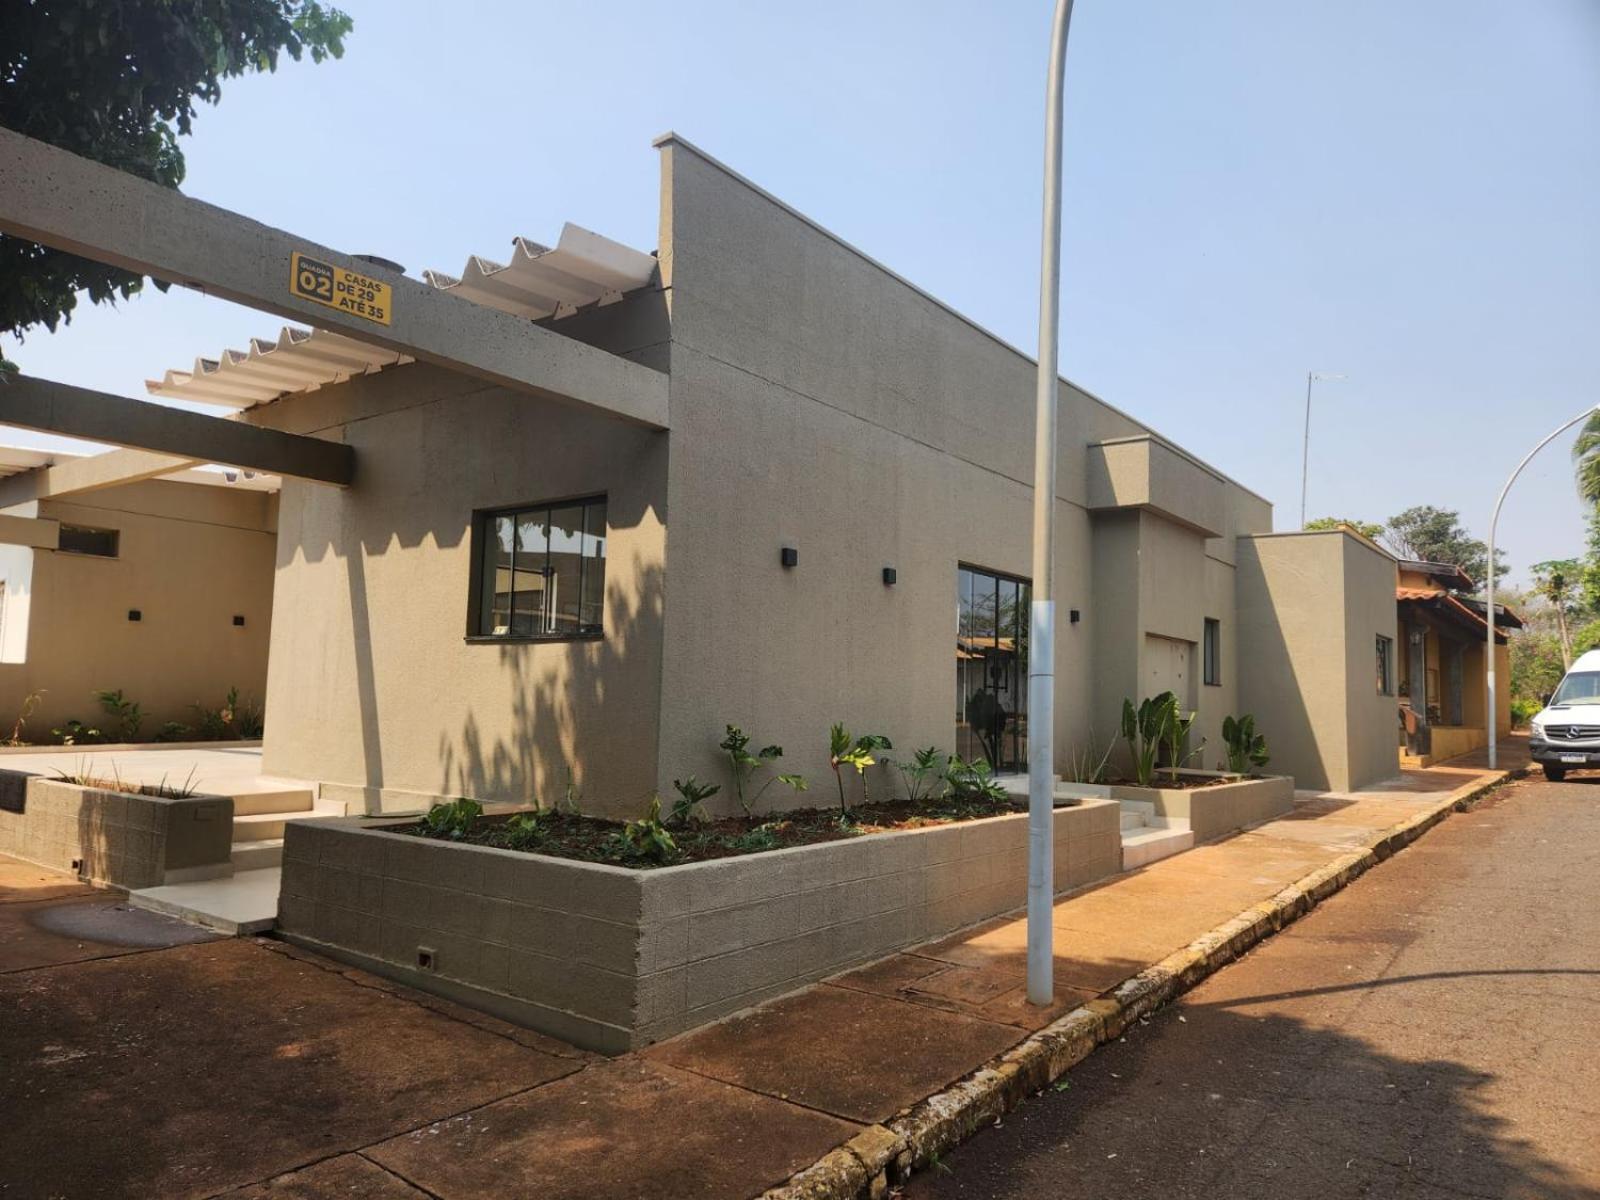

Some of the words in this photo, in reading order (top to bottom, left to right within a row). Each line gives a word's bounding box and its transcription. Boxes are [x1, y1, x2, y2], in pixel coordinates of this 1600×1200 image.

[301, 262, 331, 276] QUADRA
[300, 271, 331, 296] 02
[337, 282, 354, 296] DE
[358, 288, 375, 302] 29
[345, 273, 381, 292] CASAS
[340, 296, 365, 313] ATÉ
[368, 305, 384, 319] 35
